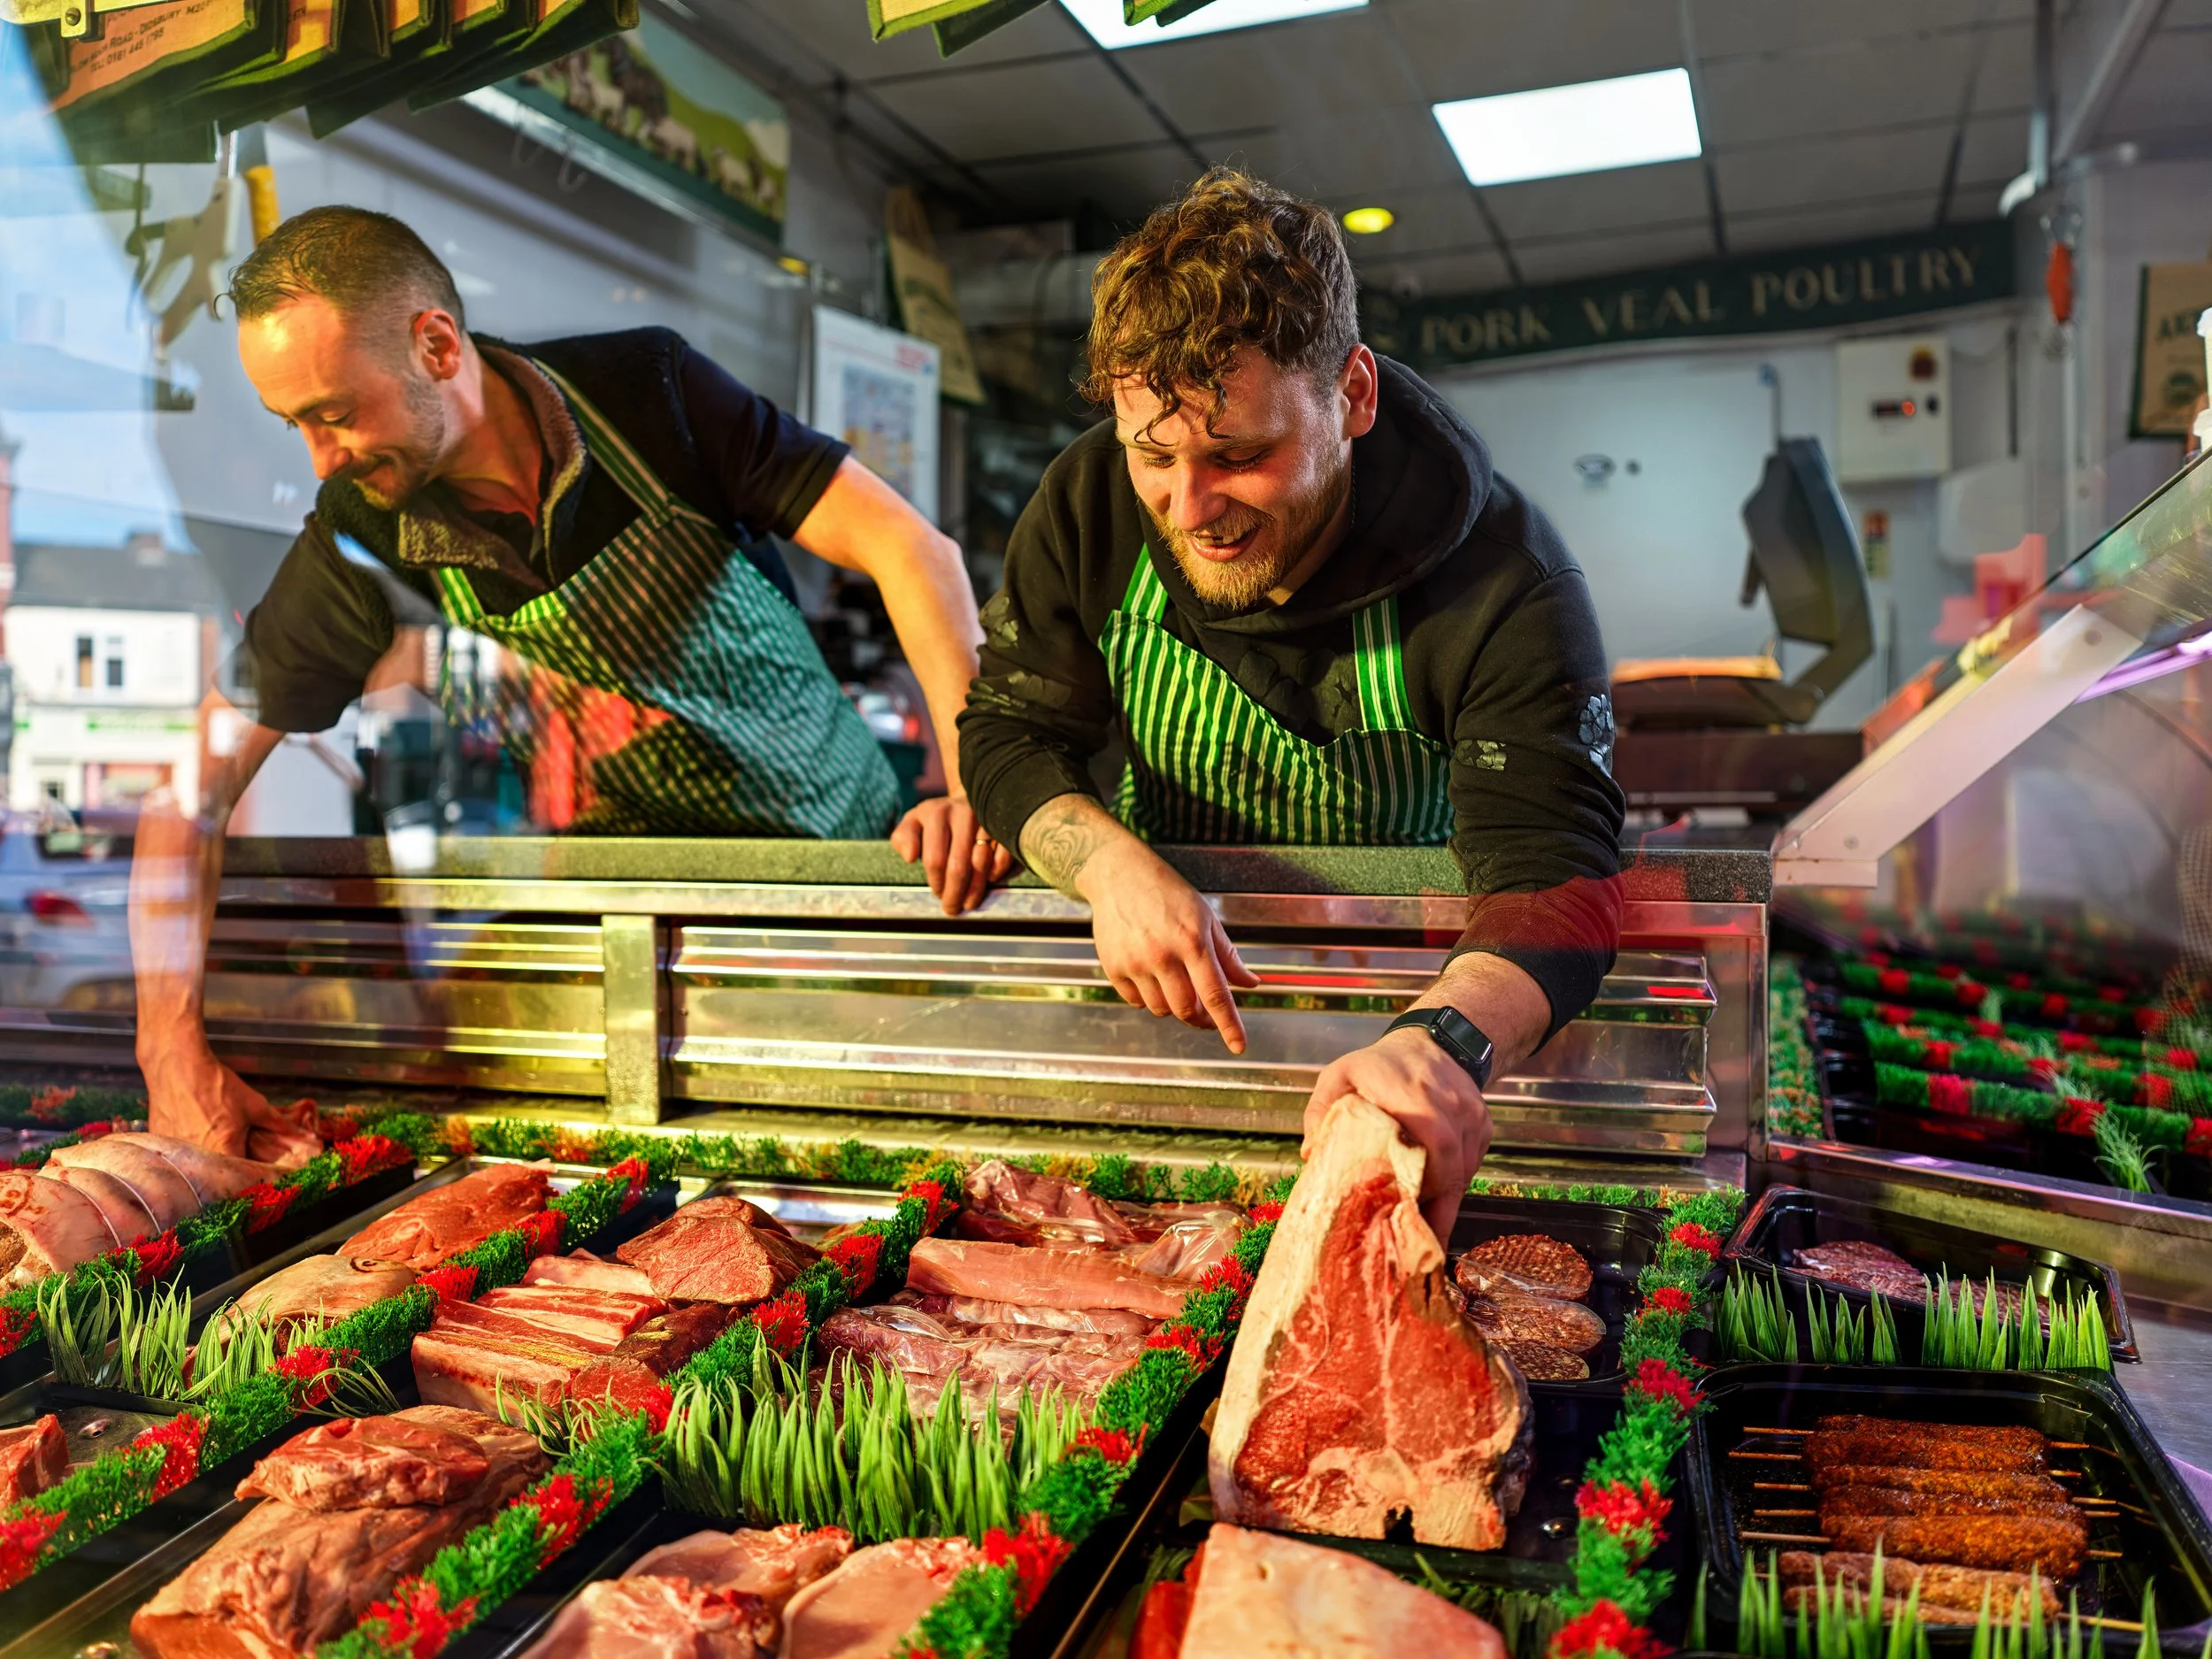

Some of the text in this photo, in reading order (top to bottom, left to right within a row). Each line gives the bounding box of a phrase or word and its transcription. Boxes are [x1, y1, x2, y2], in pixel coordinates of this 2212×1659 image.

[110, 32, 133, 50] ROAD
[1421, 305, 1551, 353] PORK
[1581, 279, 1723, 335] VEAL
[1748, 242, 1983, 316] POULTRY
